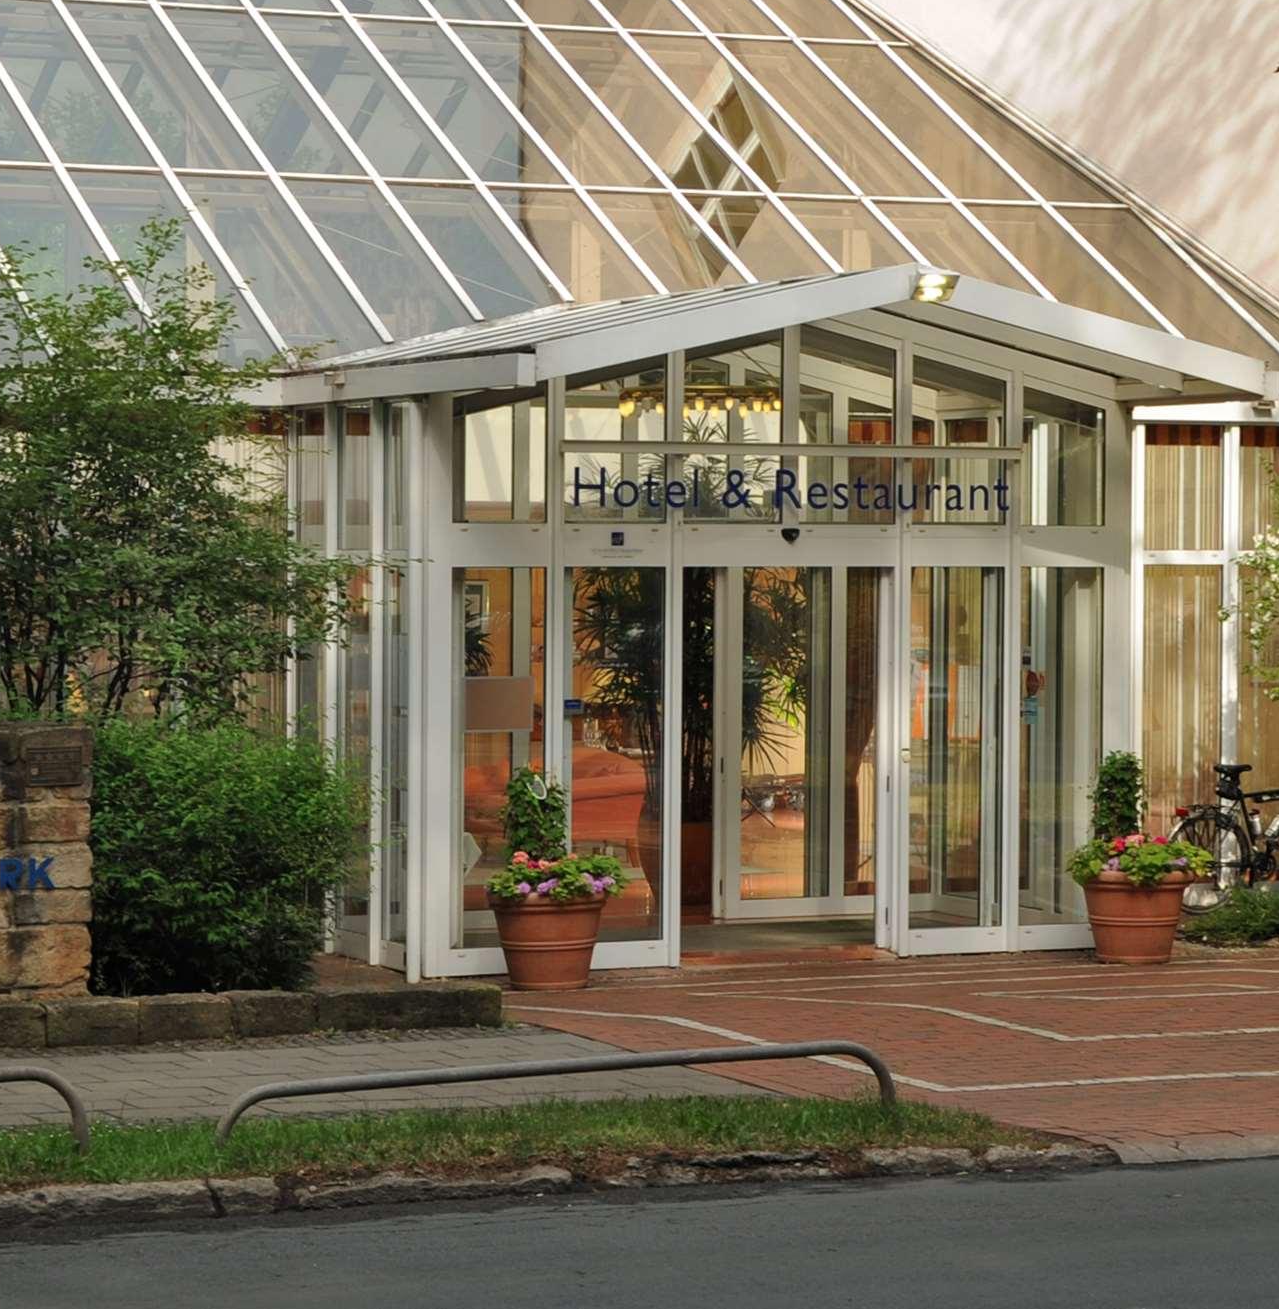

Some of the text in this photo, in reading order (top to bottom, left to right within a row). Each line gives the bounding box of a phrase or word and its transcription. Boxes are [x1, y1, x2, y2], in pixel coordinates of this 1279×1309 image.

[574, 467, 1010, 511] Hotel & Restaurant
